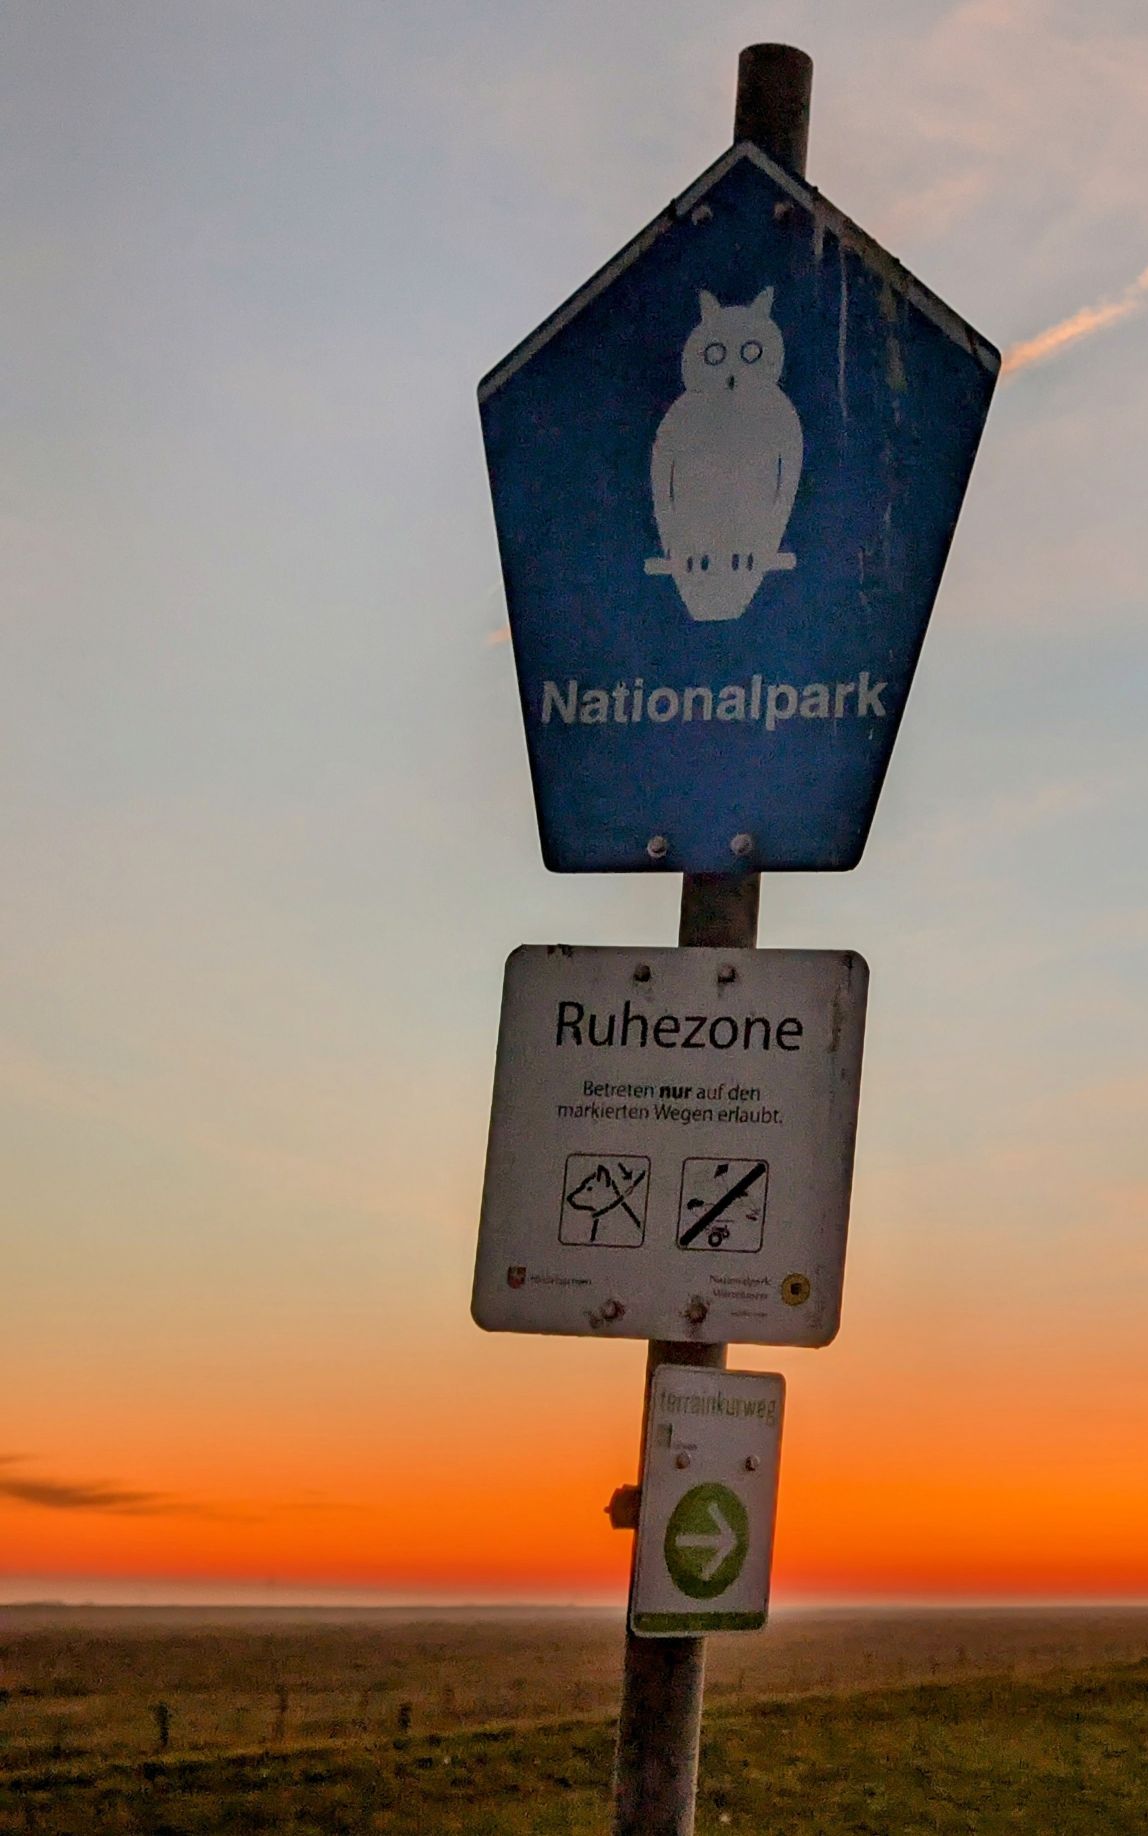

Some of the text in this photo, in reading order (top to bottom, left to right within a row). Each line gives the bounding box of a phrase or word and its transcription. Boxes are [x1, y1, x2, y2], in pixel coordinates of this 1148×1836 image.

[540, 671, 889, 732] Nationalpark
[556, 1000, 804, 1051] Ruhezone
[583, 1080, 761, 1101] Betreten nur auf den
[557, 1104, 783, 1125] markierten Wegen erlaubt.
